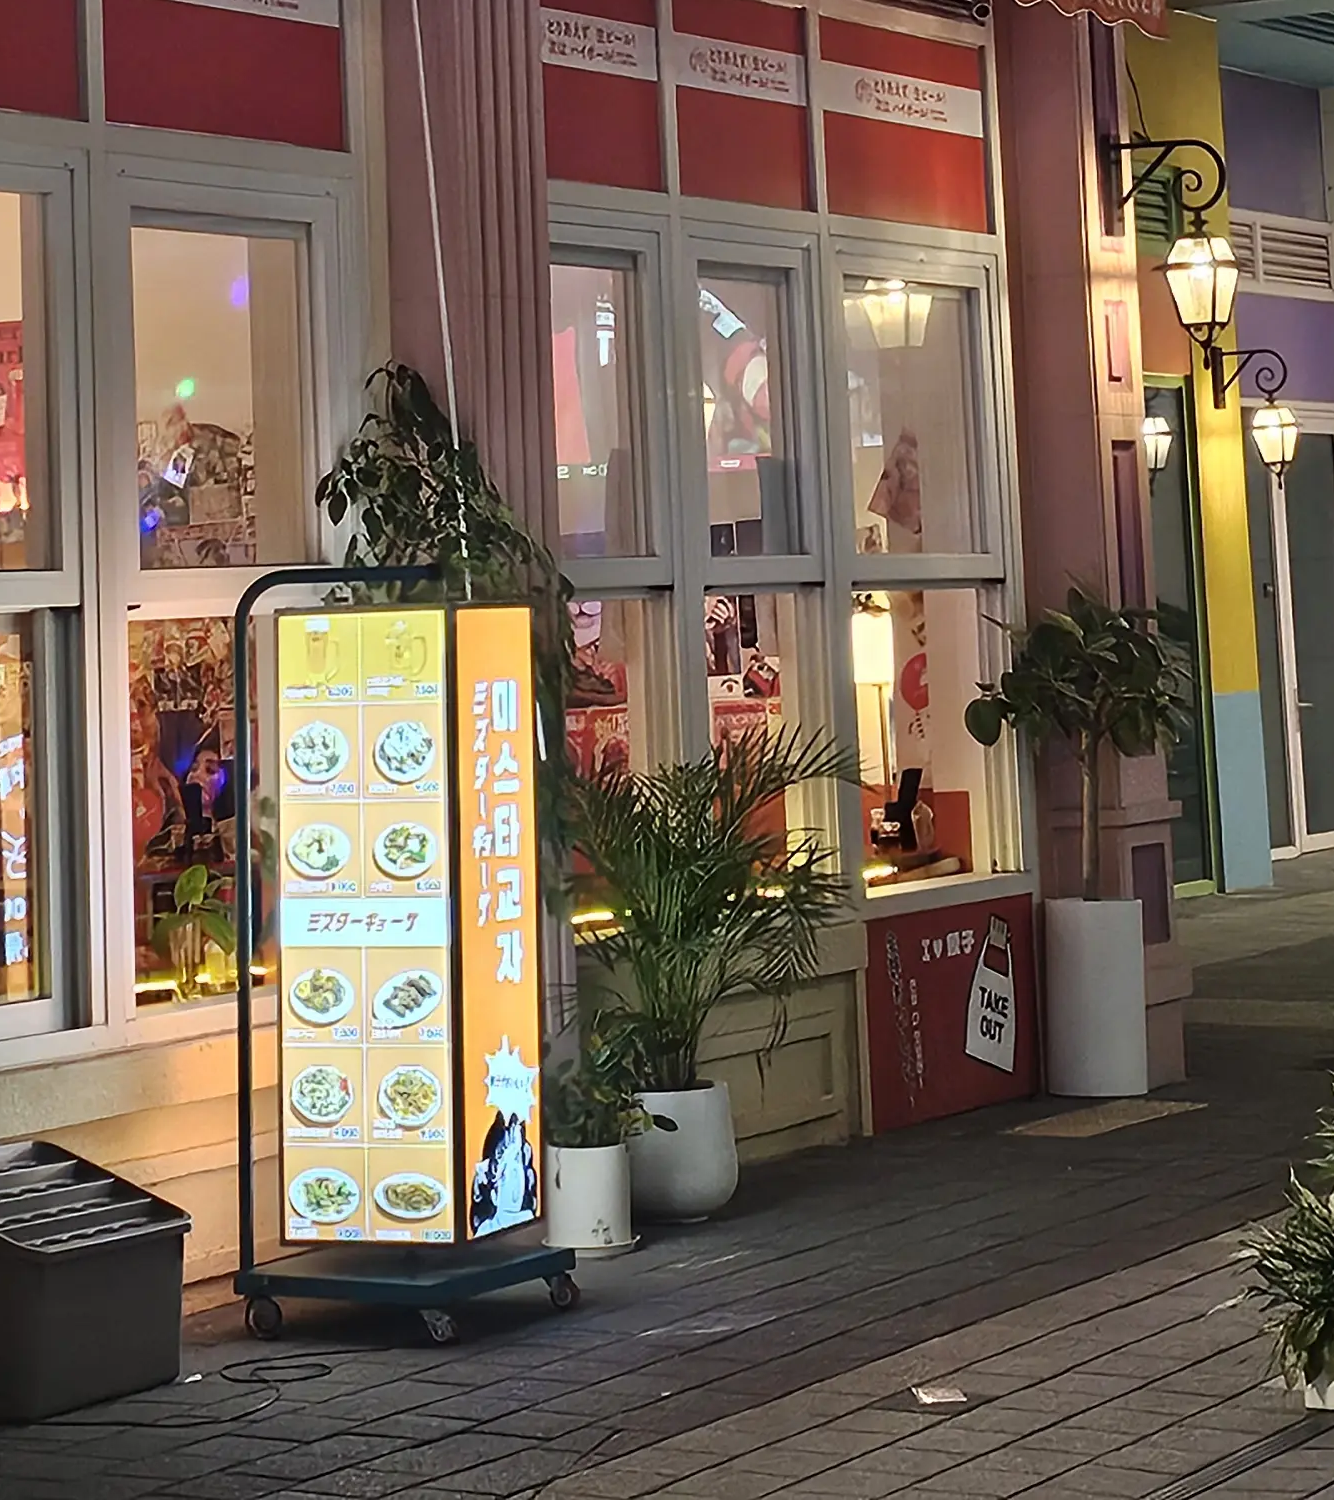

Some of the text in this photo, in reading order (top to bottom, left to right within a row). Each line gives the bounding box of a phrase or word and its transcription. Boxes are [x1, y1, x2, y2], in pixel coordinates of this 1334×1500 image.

[490, 679, 524, 984] 미스타교자
[979, 986, 1009, 1019] TAKE
[980, 1015, 1005, 1044] OUT
